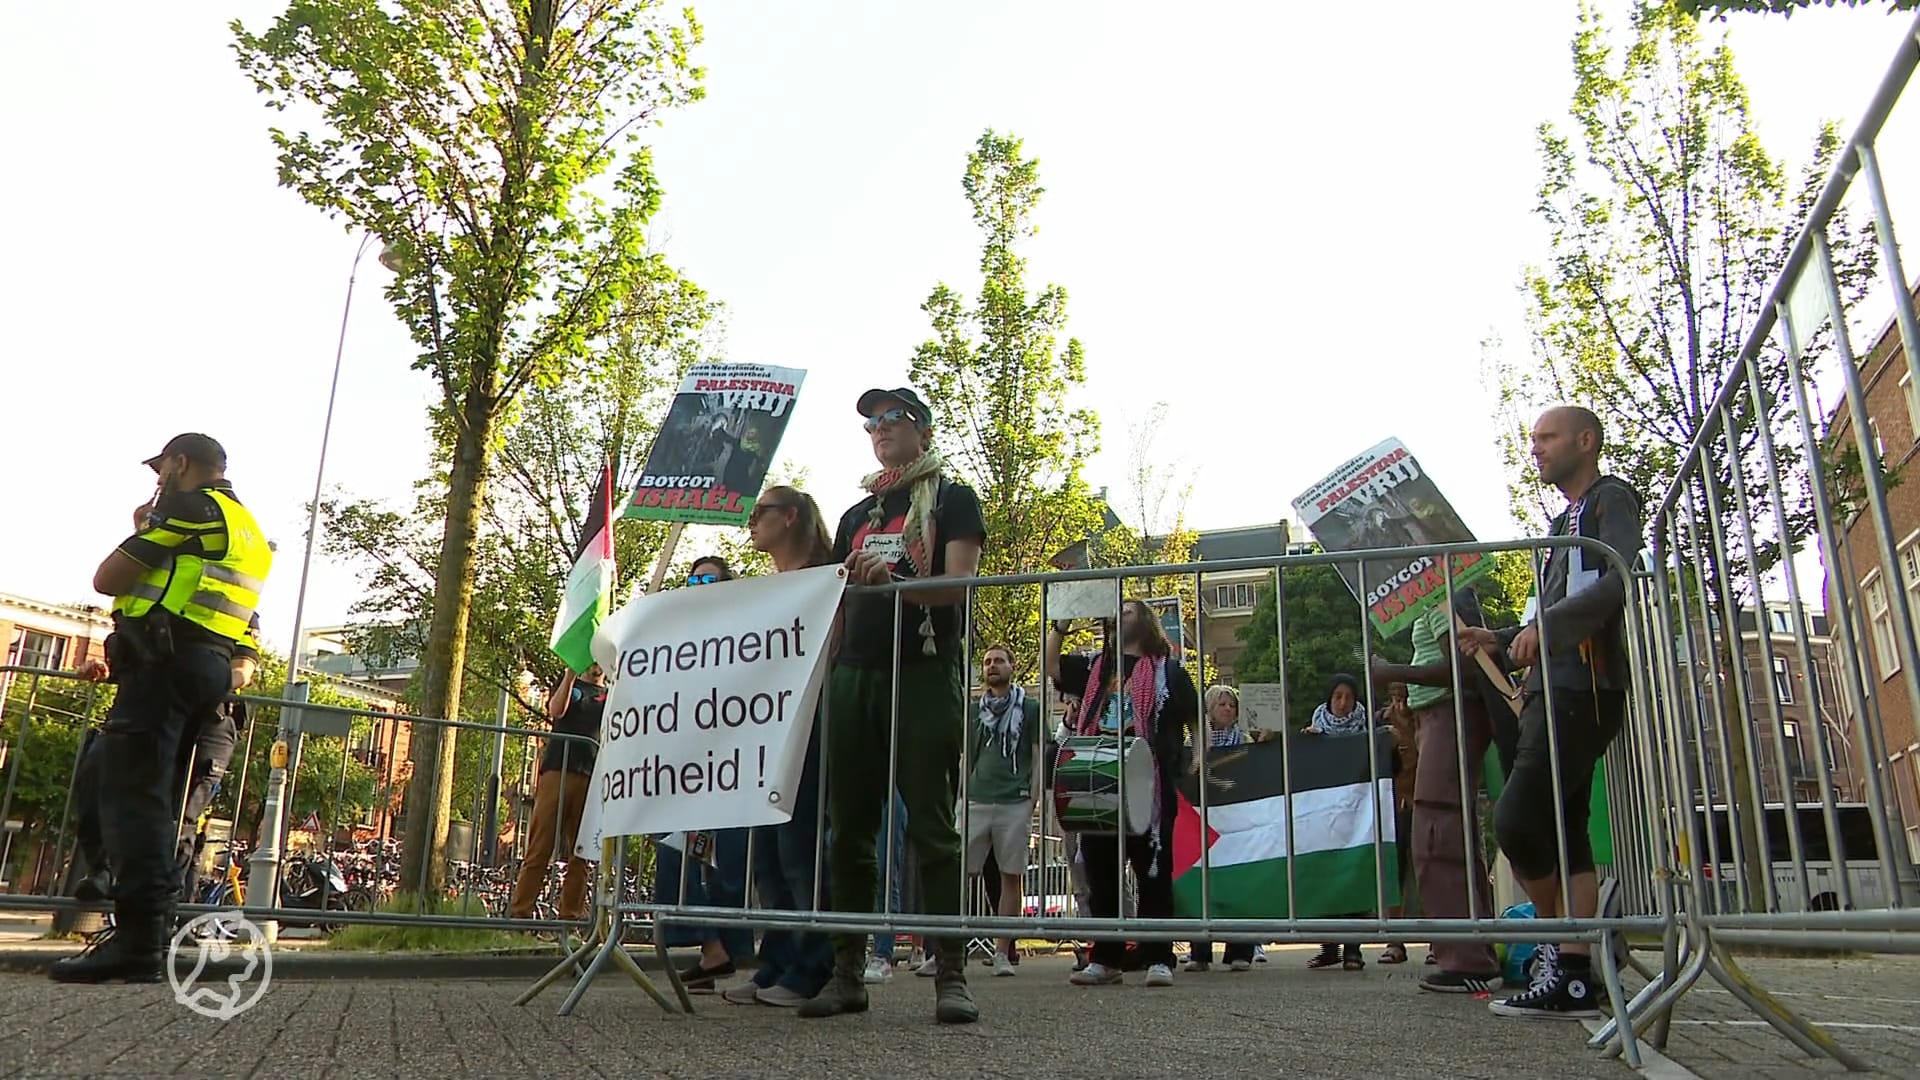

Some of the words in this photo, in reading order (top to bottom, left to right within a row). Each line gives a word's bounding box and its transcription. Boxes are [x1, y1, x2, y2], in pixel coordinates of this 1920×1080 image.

[694, 379, 795, 396] PALESTINA
[721, 391, 791, 417] VRIJ
[640, 475, 715, 488] BOYCOT
[1316, 447, 1409, 512] PALESTINA
[1322, 481, 1337, 494] aan
[1338, 455, 1375, 483] apartheid
[1353, 456, 1420, 505] VRIJ
[632, 485, 745, 513] ISRAËL
[1367, 556, 1433, 607] BOYCOT
[605, 691, 679, 743] sord
[694, 687, 793, 730] door
[758, 745, 766, 788] !
